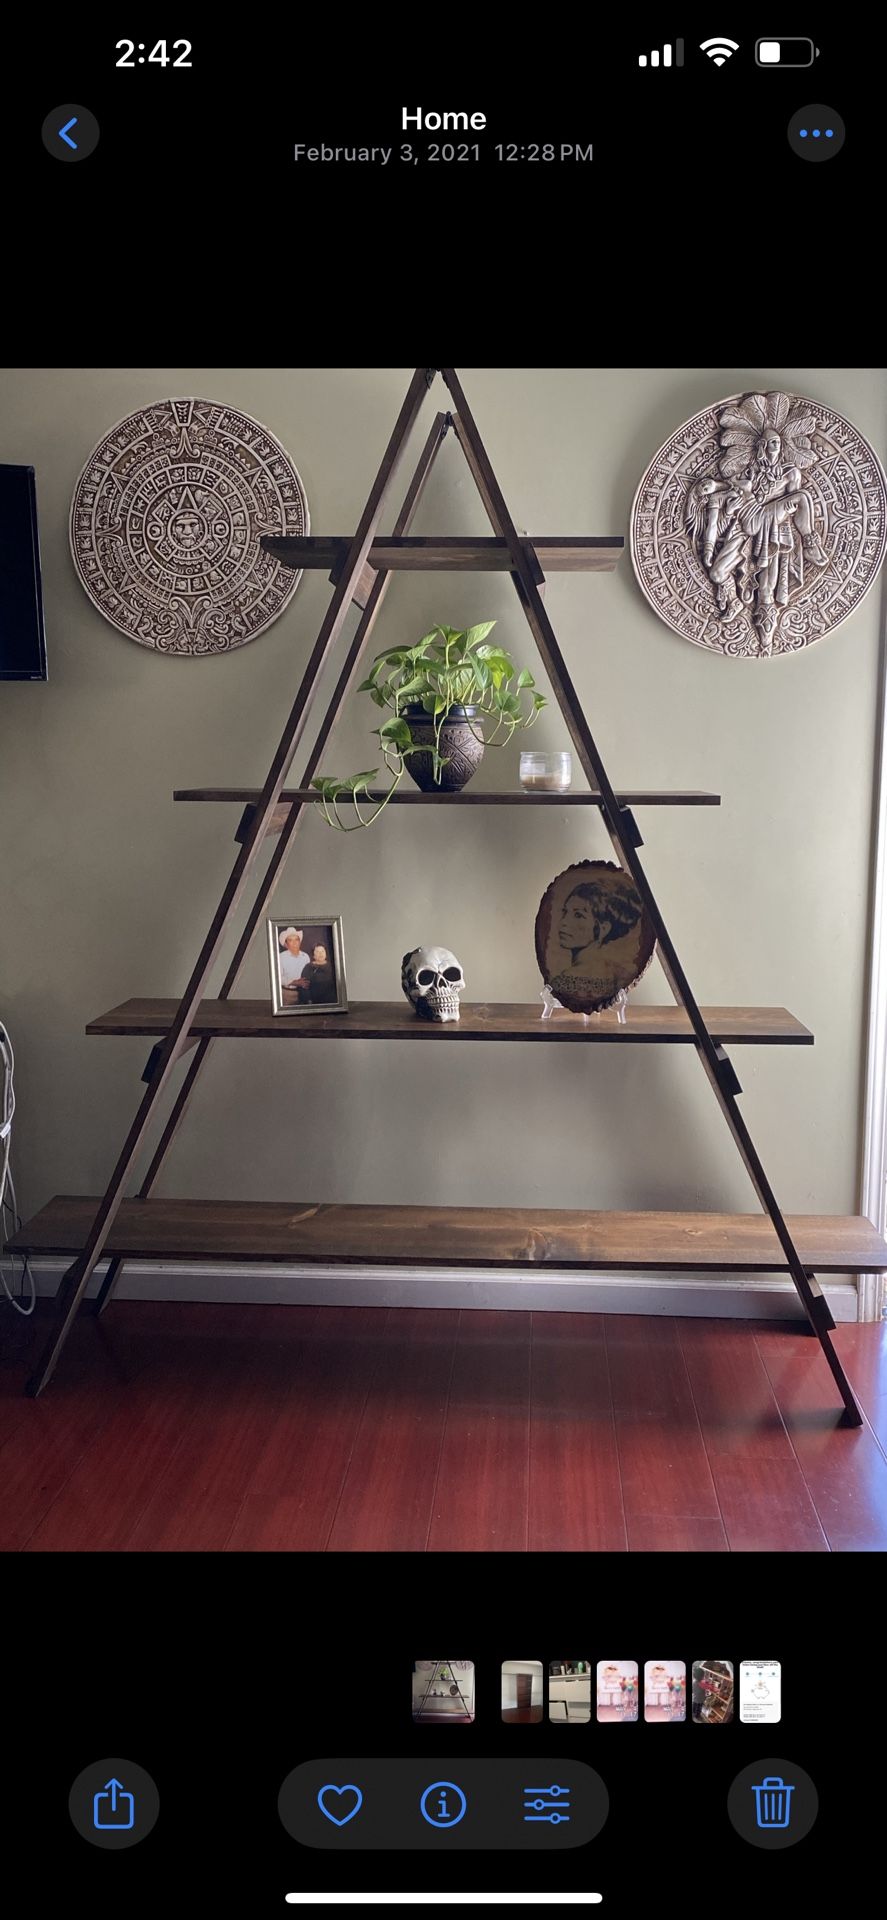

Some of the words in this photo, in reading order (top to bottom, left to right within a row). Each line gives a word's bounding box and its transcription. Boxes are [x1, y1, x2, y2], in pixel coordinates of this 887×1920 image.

[115, 38, 193, 68] 2:42
[401, 106, 487, 131] Home
[294, 143, 393, 167] February
[399, 143, 419, 166] 3,
[427, 143, 480, 162] 2021
[493, 143, 556, 162] 12:28
[560, 143, 593, 162] PM
